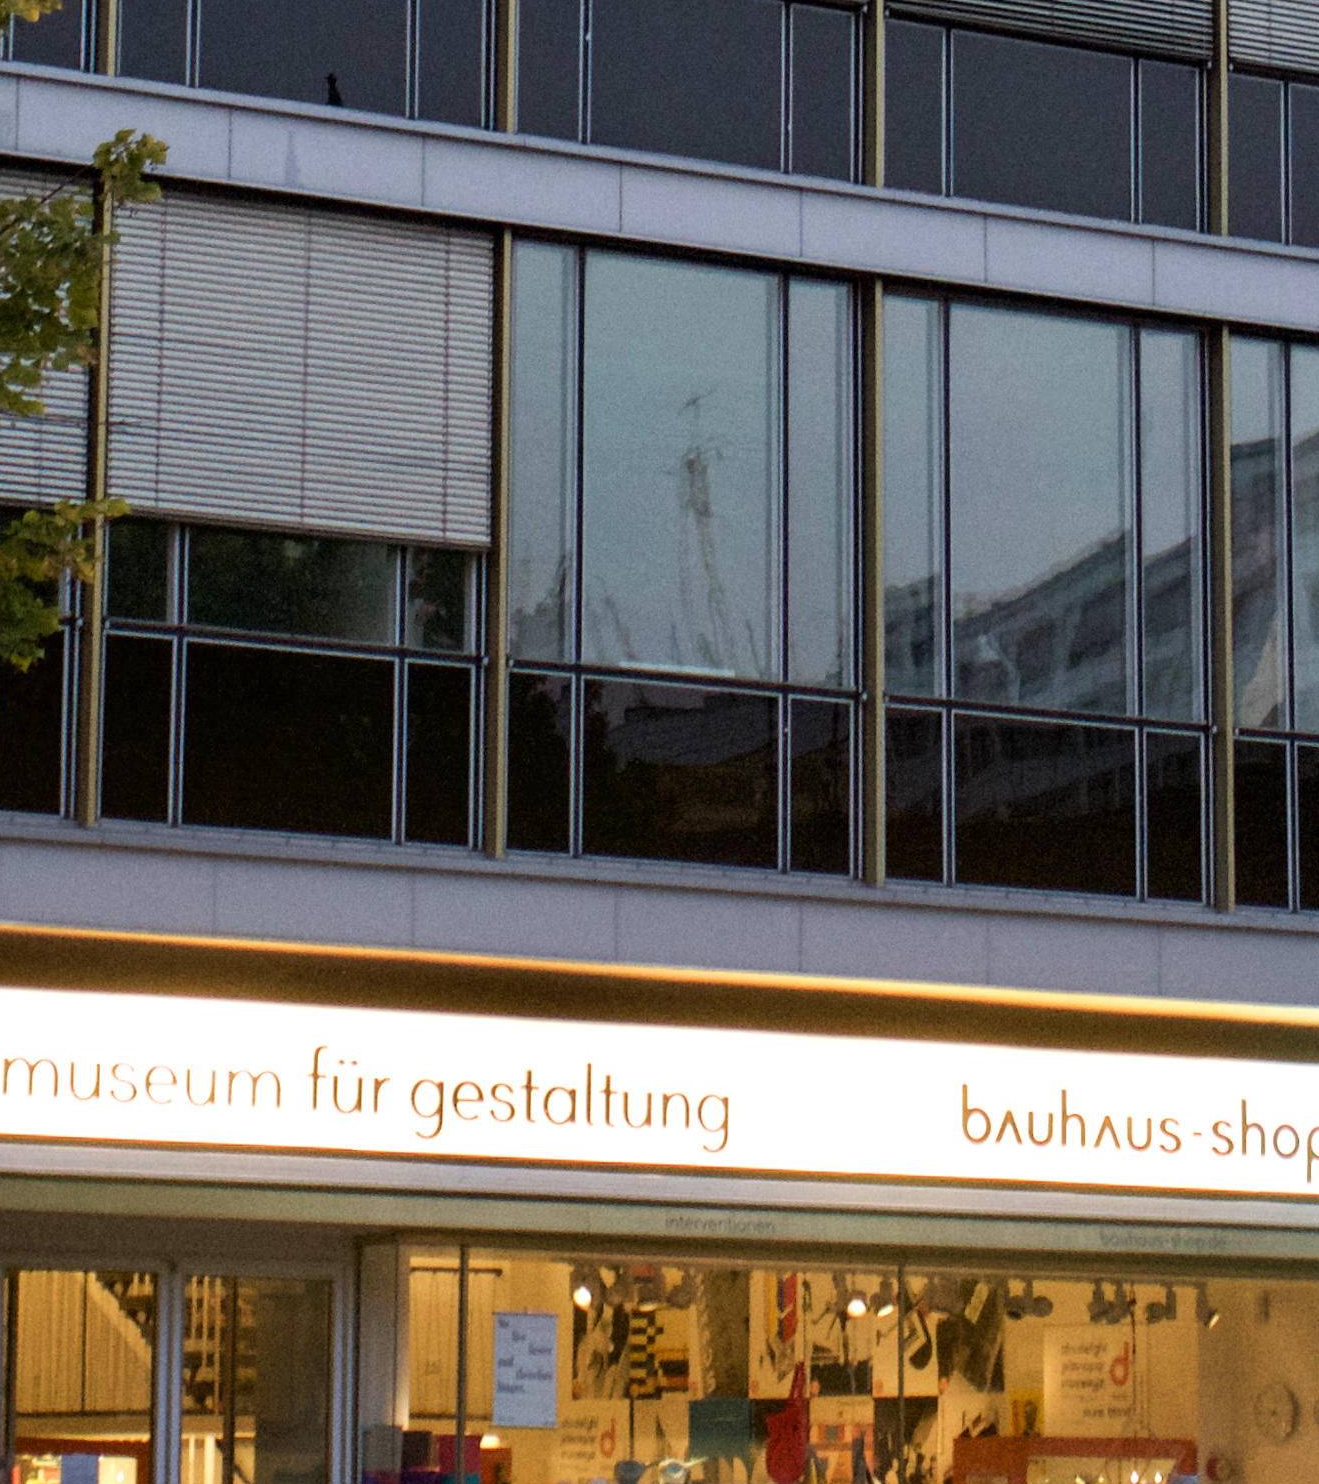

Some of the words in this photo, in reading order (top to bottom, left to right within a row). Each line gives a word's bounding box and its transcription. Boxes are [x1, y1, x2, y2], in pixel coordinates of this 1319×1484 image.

[3, 1056, 282, 1110] museum
[307, 1044, 391, 1116] für
[409, 1060, 730, 1154] gestaltung
